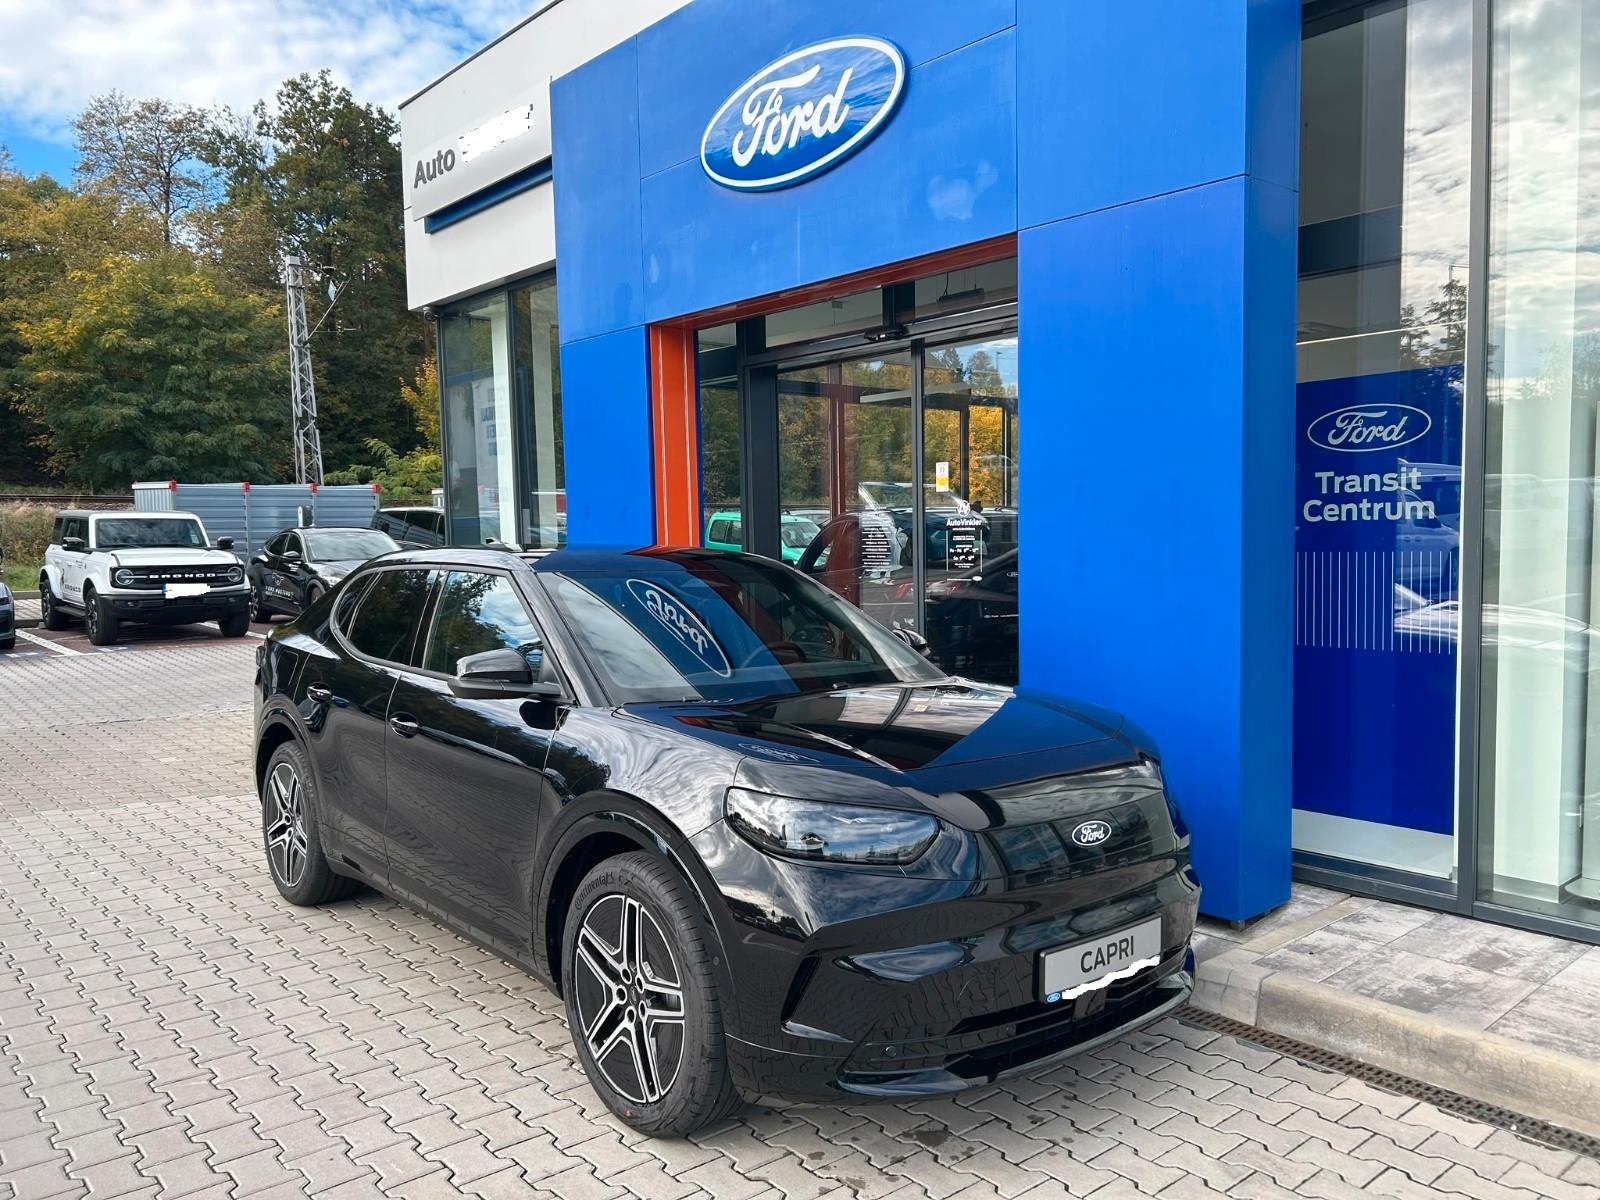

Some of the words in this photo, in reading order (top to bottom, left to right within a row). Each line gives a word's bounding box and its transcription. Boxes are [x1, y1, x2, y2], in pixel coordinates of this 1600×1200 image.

[732, 64, 854, 167] Ford
[413, 148, 456, 189] Auto
[1327, 410, 1408, 446] Ford
[1314, 466, 1422, 495] Transit
[1303, 498, 1435, 523] Centrum
[1080, 824, 1105, 843] Ford
[1080, 935, 1135, 973] CAPRI
